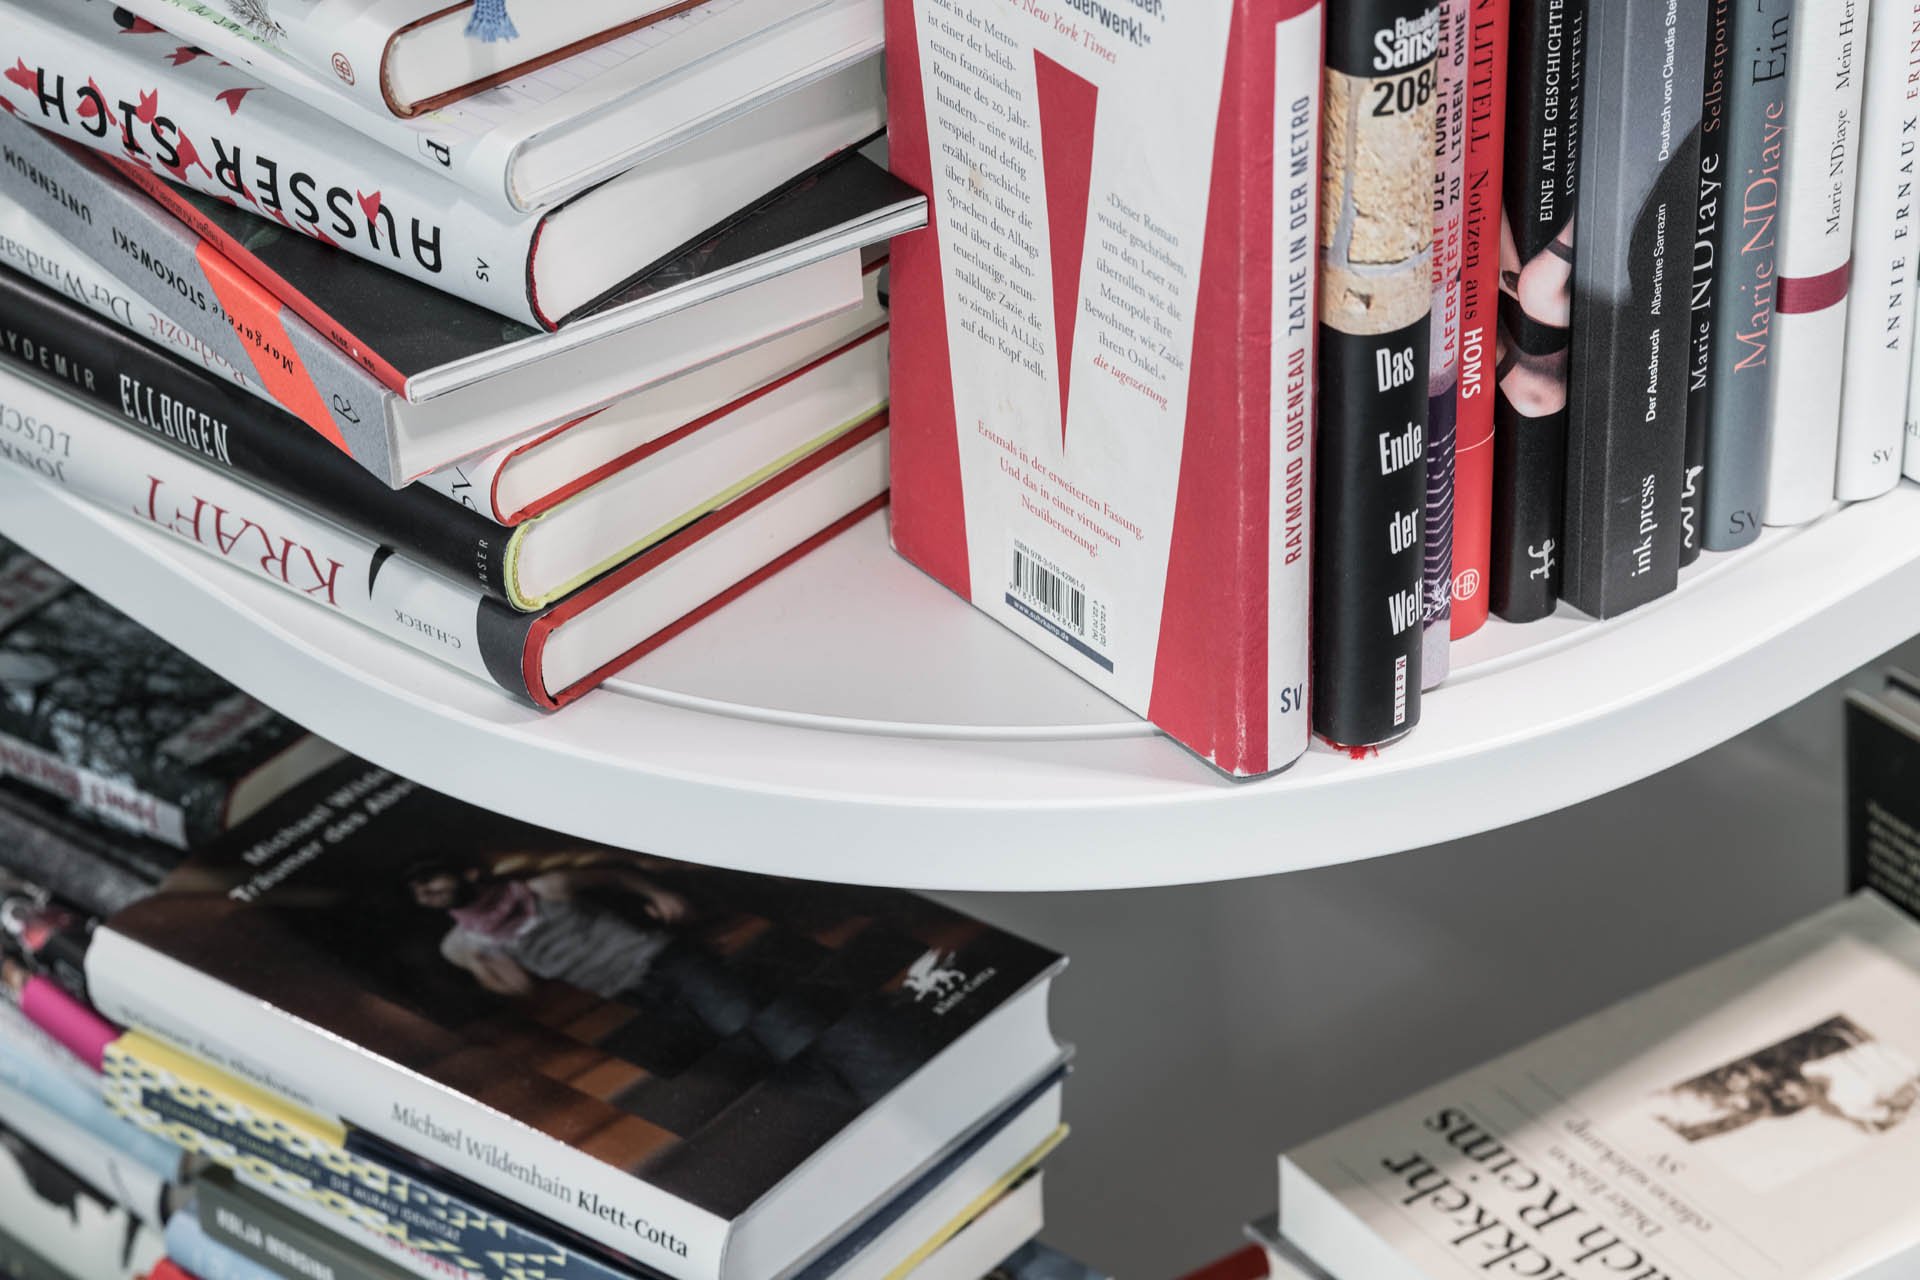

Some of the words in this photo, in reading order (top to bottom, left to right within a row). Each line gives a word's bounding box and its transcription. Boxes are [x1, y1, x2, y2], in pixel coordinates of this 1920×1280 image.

[927, 10, 939, 30] ist
[941, 20, 964, 42] einer
[967, 35, 982, 54] der
[985, 42, 1017, 71] belieb-
[954, 2, 964, 18] in
[966, 9, 981, 28] der
[1022, 0, 1050, 23] New
[1053, 12, 1078, 42] York
[1083, 29, 1118, 64] Times
[1454, 9, 1466, 67] OHNE
[930, 39, 957, 63] testen
[960, 53, 1022, 101] französischen
[1544, 0, 1564, 121] GESCHICHTE
[1571, 10, 1583, 91] LITTELL
[1663, 27, 1676, 79] Claudia
[1751, 12, 1789, 87] Ein
[1835, 41, 1853, 91] Mein
[37, 67, 180, 168] SICH
[933, 61, 972, 95] Romane
[973, 87, 990, 106] des
[1007, 106, 1031, 128] Jahr-
[1470, 20, 1495, 153] LITTELL
[1663, 79, 1673, 104] von
[936, 85, 978, 124] hunderts
[986, 122, 1006, 141] eine
[1009, 137, 1037, 160] wilde,
[938, 116, 976, 147] verspielt
[979, 142, 997, 159] und
[999, 152, 1027, 181] deftig
[1291, 96, 1310, 178] METRO
[1451, 79, 1464, 164] LIEBEN
[1542, 126, 1557, 172] ALTE
[1565, 95, 1578, 196] JONATHAN
[1658, 103, 1672, 161] Deutsch
[1828, 108, 1851, 179] NDiaye
[2, 145, 92, 225] UNTENRUM
[211, 136, 443, 274] AUSSER
[942, 142, 978, 170] erzählte
[979, 162, 1031, 204] Geschichte
[945, 165, 966, 187] über
[968, 177, 992, 205] Paris,
[995, 196, 1016, 219] über
[1018, 211, 1034, 230] die
[1450, 175, 1461, 205] ZU
[1540, 178, 1554, 222] EINE
[1741, 99, 1788, 256] NDiaye
[1894, 115, 1917, 241] ERNAUX
[946, 188, 988, 225] Sprachen
[990, 217, 1006, 236] des
[1007, 228, 1040, 260] Alltags
[1097, 212, 1129, 238] wurde
[1143, 213, 1179, 247] Roman
[1290, 182, 1308, 231] DER
[1466, 168, 1489, 268] Notizen
[1653, 203, 1666, 256] Sarrazin
[1824, 181, 1844, 237] Marie
[112, 227, 206, 311] STOKOWSKI
[476, 257, 490, 283] SV
[950, 217, 968, 236] und
[970, 228, 991, 250] über
[993, 243, 1008, 261] die
[1009, 254, 1036, 278] aben-
[953, 242, 1008, 286] teuerlustige,
[1010, 280, 1037, 302] neun-
[1102, 239, 1119, 256] um
[1121, 247, 1139, 269] den
[1141, 259, 1166, 287] Leser
[1168, 280, 1180, 296] zu
[1289, 235, 1307, 263] IN
[90, 281, 134, 327] Der
[955, 267, 997, 302] malkluge
[999, 291, 1026, 321] Zazie,
[1027, 312, 1042, 331] die
[1096, 257, 1146, 298] überrollen
[1148, 290, 1165, 310] wie
[1167, 301, 1182, 322] die
[1100, 282, 1151, 325] Metropole
[1153, 316, 1173, 338] ihre
[1288, 266, 1307, 337] ZAZIE
[1465, 279, 1479, 321] aus
[1651, 258, 1664, 315] Albertine
[1733, 259, 1774, 374] Marie
[1885, 256, 1905, 351] ANNIE
[211, 303, 294, 375] Margarete
[958, 292, 968, 305] so
[969, 300, 1009, 332] ziemlich
[1011, 324, 1045, 355] ALLES
[960, 318, 977, 333] auf
[977, 325, 995, 346] den
[998, 336, 1022, 364] Kopf
[1022, 357, 1047, 382] stellt.
[1085, 298, 1137, 341] Bewohner,
[1139, 334, 1156, 352] wie
[1158, 343, 1184, 371] Zazie
[1098, 331, 1125, 357] ihren
[1093, 353, 1109, 371] die
[1110, 365, 1168, 411] tageszeitung
[1375, 346, 1415, 393] Das
[1462, 326, 1484, 400] HOMS
[1646, 328, 1660, 392] Ausbruch
[1690, 320, 1710, 392] Marie
[0, 329, 96, 391] YDEMIR
[120, 373, 233, 466] ELLBOGEN
[1286, 347, 1305, 453] QUENEAU
[1645, 395, 1657, 423] Der
[977, 419, 1017, 456] Erstmals
[1019, 446, 1028, 464] in
[1031, 456, 1047, 475] der
[1048, 473, 1100, 511] erweiterten
[1379, 421, 1422, 476] Ende
[1871, 446, 1894, 465] SV
[1000, 456, 1020, 481] Und
[1023, 473, 1038, 493] das
[1040, 484, 1049, 500] in
[1052, 494, 1075, 518] einer
[1077, 511, 1121, 548] virtuosen
[1021, 493, 1098, 558] Neuübersetzung!
[1285, 457, 1304, 566] RAYMOND
[1389, 508, 1419, 555] der
[1638, 474, 1658, 535] press
[1728, 509, 1761, 535] SV
[132, 474, 345, 608] KRAFT
[1631, 535, 1653, 577] ink
[393, 608, 463, 650] C.H.BECK
[1388, 577, 1424, 636] Welt
[1280, 683, 1303, 714] SV
[1395, 658, 1407, 722] Merlin
[391, 1101, 463, 1151] Michael
[463, 1135, 573, 1203] Wildenhain
[578, 1188, 690, 1260] Klett-Cotta
[1422, 1106, 1582, 1231] Reims
[1379, 1152, 1567, 1280] ckkehr
